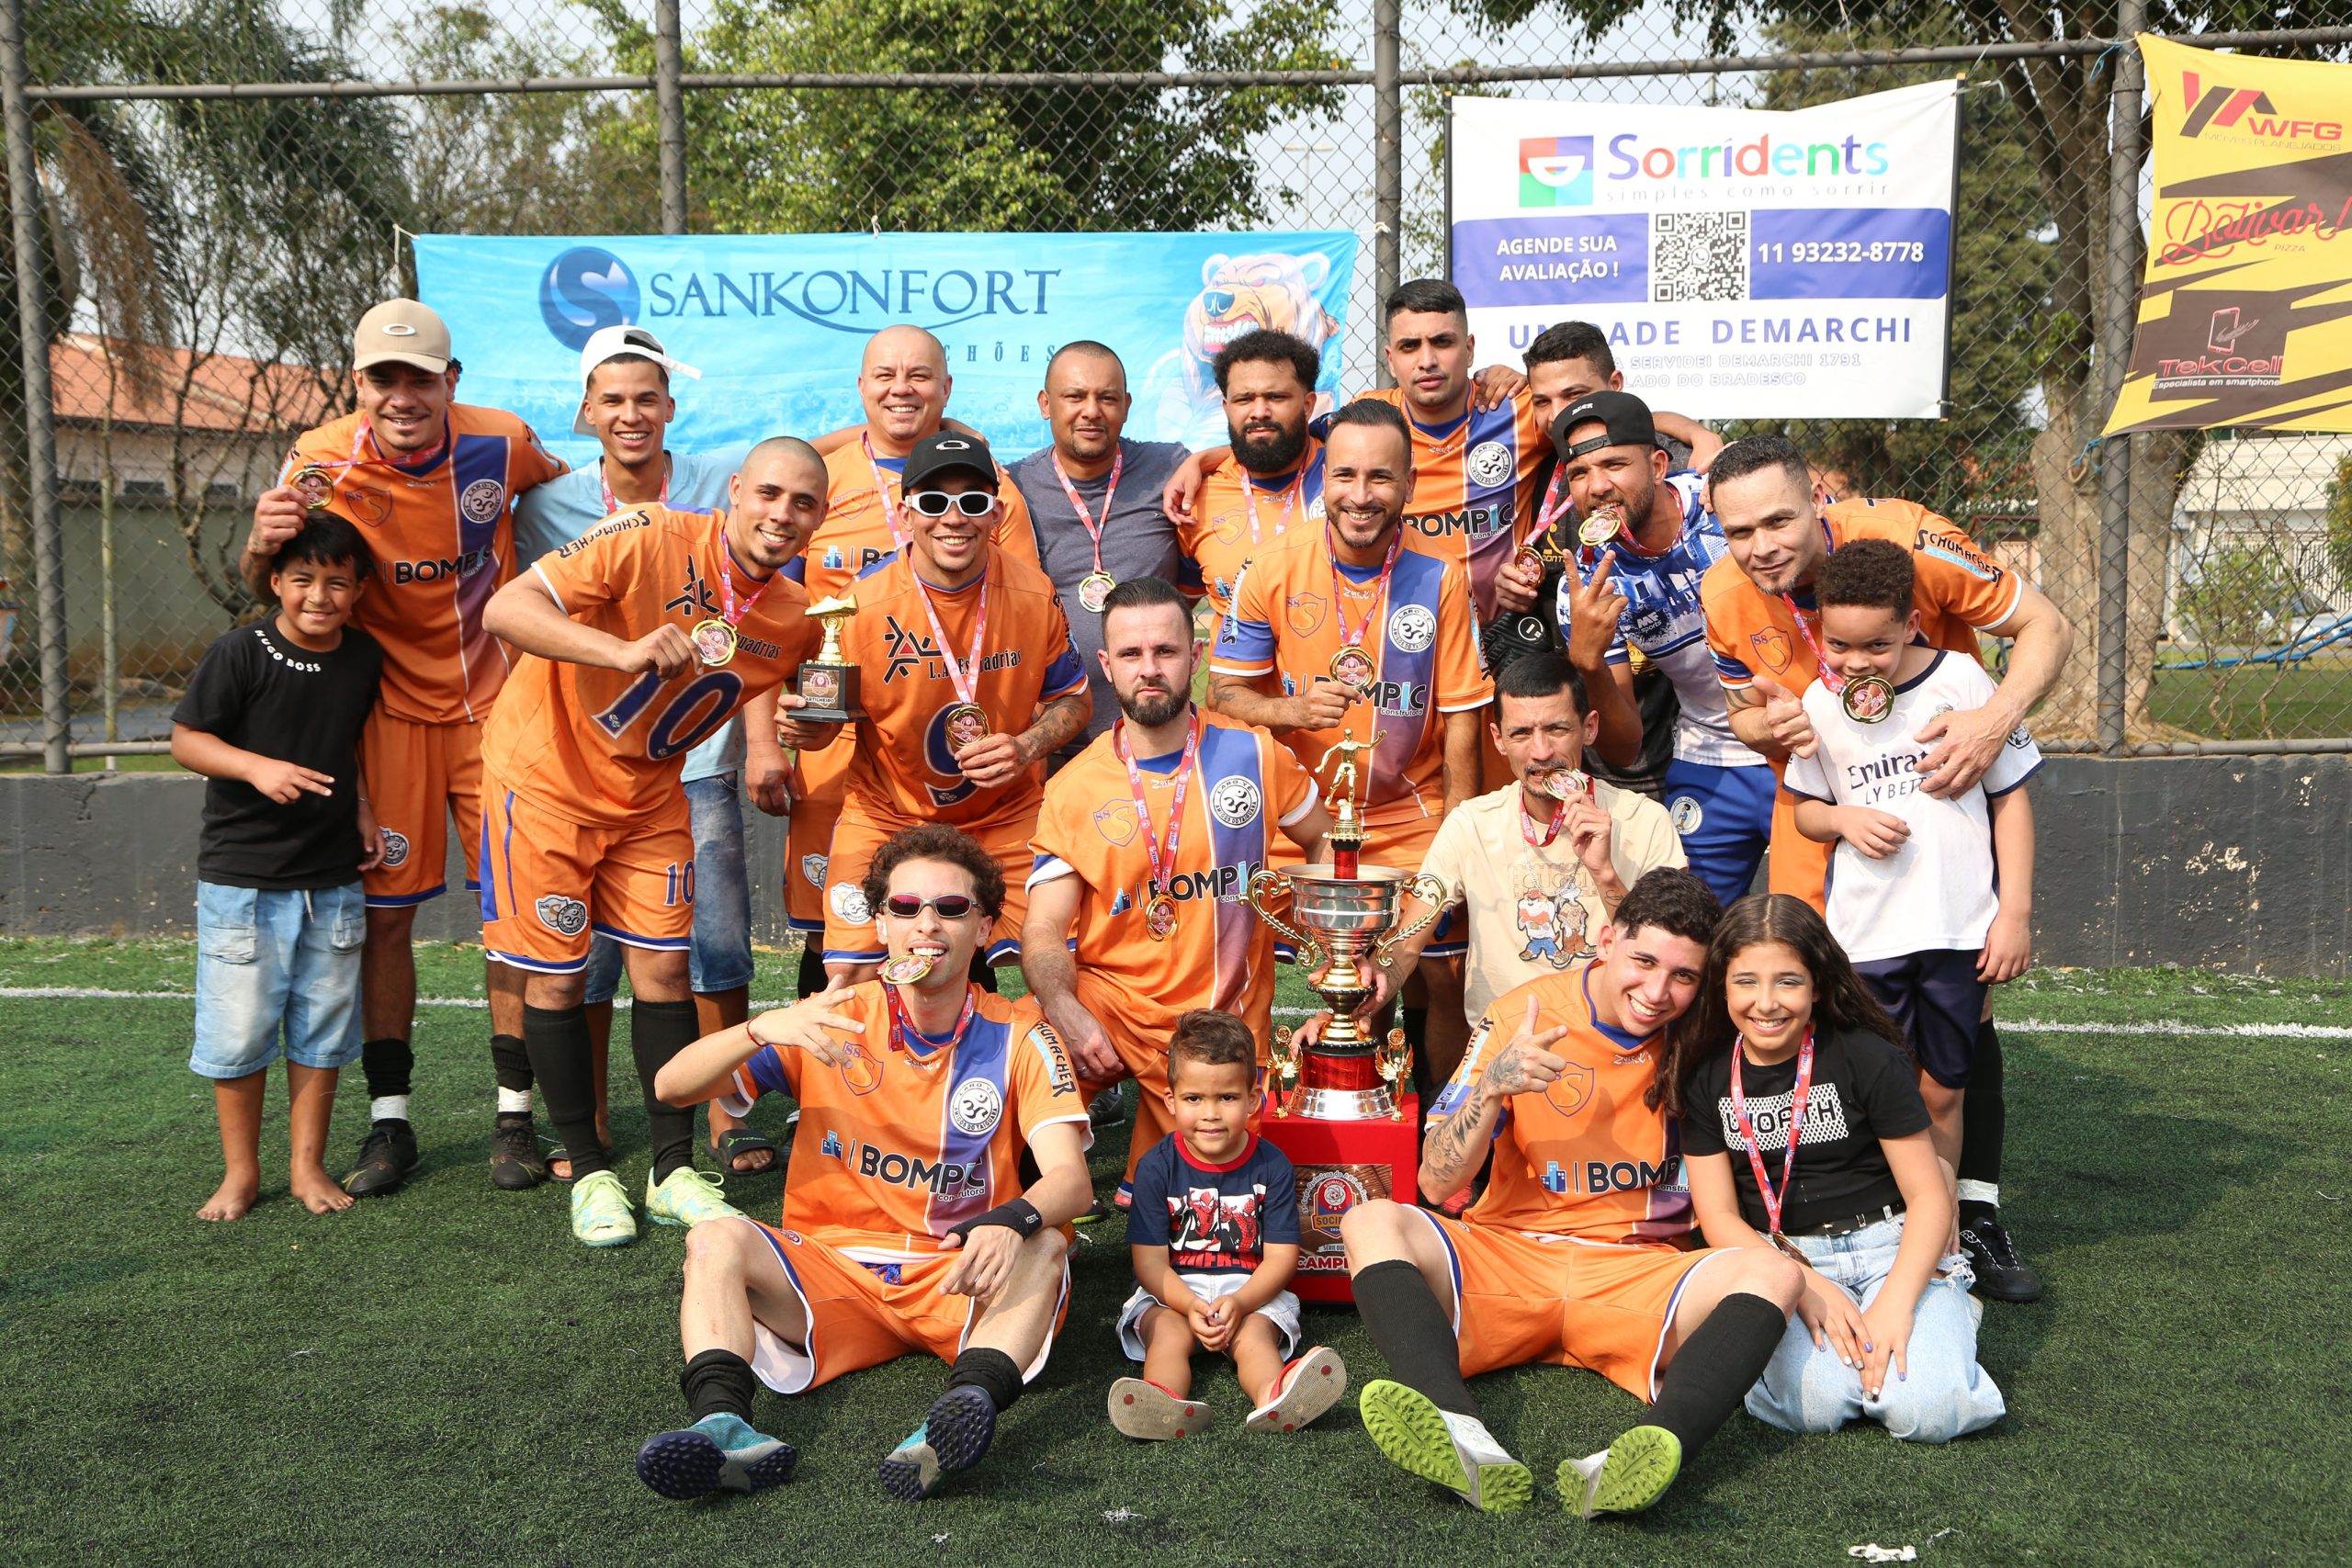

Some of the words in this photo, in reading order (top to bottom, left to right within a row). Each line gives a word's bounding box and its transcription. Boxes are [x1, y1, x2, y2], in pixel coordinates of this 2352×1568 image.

[2247, 117, 2343, 141] WFG
[1608, 134, 1888, 180] Sorridents
[1607, 186, 1708, 202] simples
[1727, 185, 1792, 197] como
[1812, 182, 1888, 197] sorrir
[1497, 237, 1574, 254] AGENDE
[1578, 235, 1617, 253] SUA
[1758, 243, 1784, 264] 11
[1792, 241, 1925, 263] 93232-8778
[2274, 244, 2306, 253] PIZZA
[1498, 259, 1608, 283] AVALIAÇÃO
[650, 269, 1061, 321] SANKONFORT
[1510, 321, 1680, 349] UADE
[1712, 318, 1912, 344] DEMARCHI
[1630, 356, 1713, 368] SERVIDEI
[1719, 354, 1813, 367] DEMARCHI
[1820, 354, 1861, 367] 1791
[2159, 355, 2284, 377] TekCell
[1623, 374, 1670, 388] LADO
[1678, 374, 1702, 387] DO
[1710, 372, 1806, 386] BRADESCO
[2153, 378, 2206, 389] Especialista
[1914, 529, 2003, 588] SCHUMACHER
[1637, 612, 1659, 628] MF
[1641, 620, 1662, 634] sports
[254, 629, 283, 660] HUGO
[286, 658, 322, 672] BOSS
[591, 669, 744, 762] 10
[1848, 751, 1928, 790] Emira
[662, 859, 695, 908] 10
[1037, 1022, 1077, 1098] HUMACHER
[1298, 1258, 1349, 1270] CAMP
